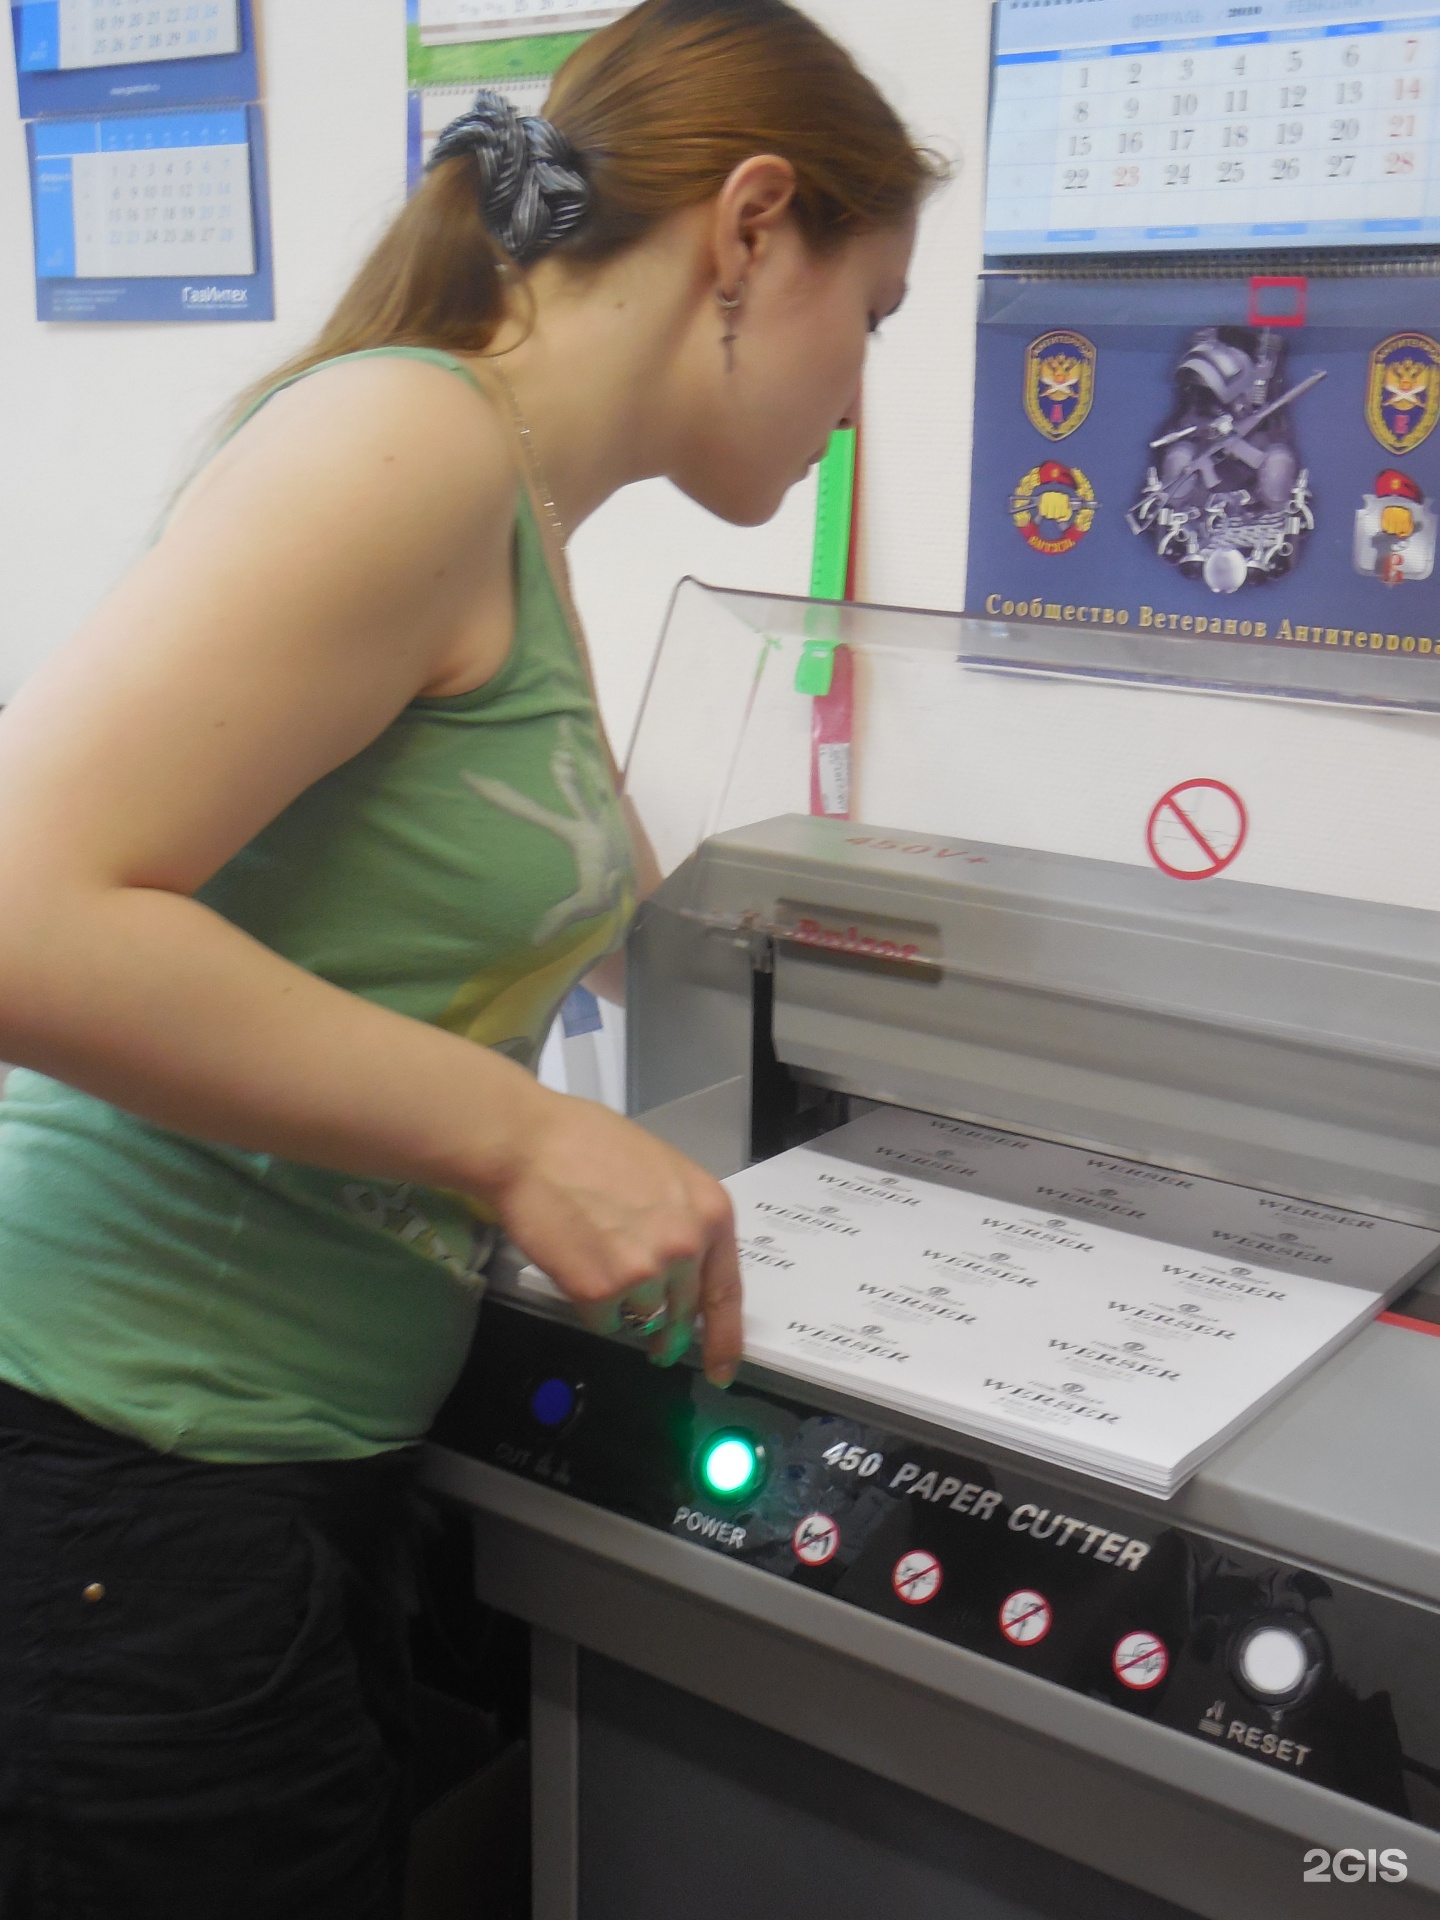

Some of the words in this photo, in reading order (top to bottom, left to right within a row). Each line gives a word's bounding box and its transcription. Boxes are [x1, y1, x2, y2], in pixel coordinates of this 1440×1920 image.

[1079, 67, 1089, 88] 1
[1127, 63, 1142, 84] 2
[1179, 59, 1195, 80] 3
[1232, 55, 1246, 75] 4
[1287, 50, 1303, 72] 5
[1342, 45, 1360, 67] 6
[1404, 40, 1418, 62] 7
[1072, 101, 1089, 122] 8
[1123, 97, 1140, 119] 9
[1172, 93, 1198, 116] 10
[1225, 90, 1248, 112] 11
[1279, 85, 1307, 108] 12
[1336, 81, 1363, 104] 13
[1394, 78, 1421, 101] 14
[1068, 135, 1092, 156] 15
[1118, 132, 1143, 153] 16
[1169, 129, 1195, 151] 17
[1223, 126, 1249, 148] 18
[1276, 122, 1304, 144] 19
[1329, 118, 1360, 140] 20
[1388, 115, 1416, 137] 21
[1062, 168, 1089, 189] 22
[1113, 166, 1139, 187] 23
[1164, 163, 1191, 185] 24
[1217, 161, 1245, 183] 25
[1270, 158, 1300, 180] 26
[1326, 155, 1356, 178] 27
[1385, 152, 1415, 175] 28
[985, 594, 1130, 626] Сообщество
[1138, 605, 1268, 638] Ветеранов
[1258, 1198, 1376, 1230] WERSER
[1211, 1230, 1333, 1264] WERSER
[1161, 1264, 1287, 1302] WERSER
[1108, 1300, 1238, 1340] WERSER
[673, 1506, 747, 1549] POWER
[822, 1441, 883, 1478] 450
[890, 1462, 1003, 1521] PAPER
[1006, 1502, 1152, 1573] CUTTER
[1227, 1720, 1312, 1767] RESET
